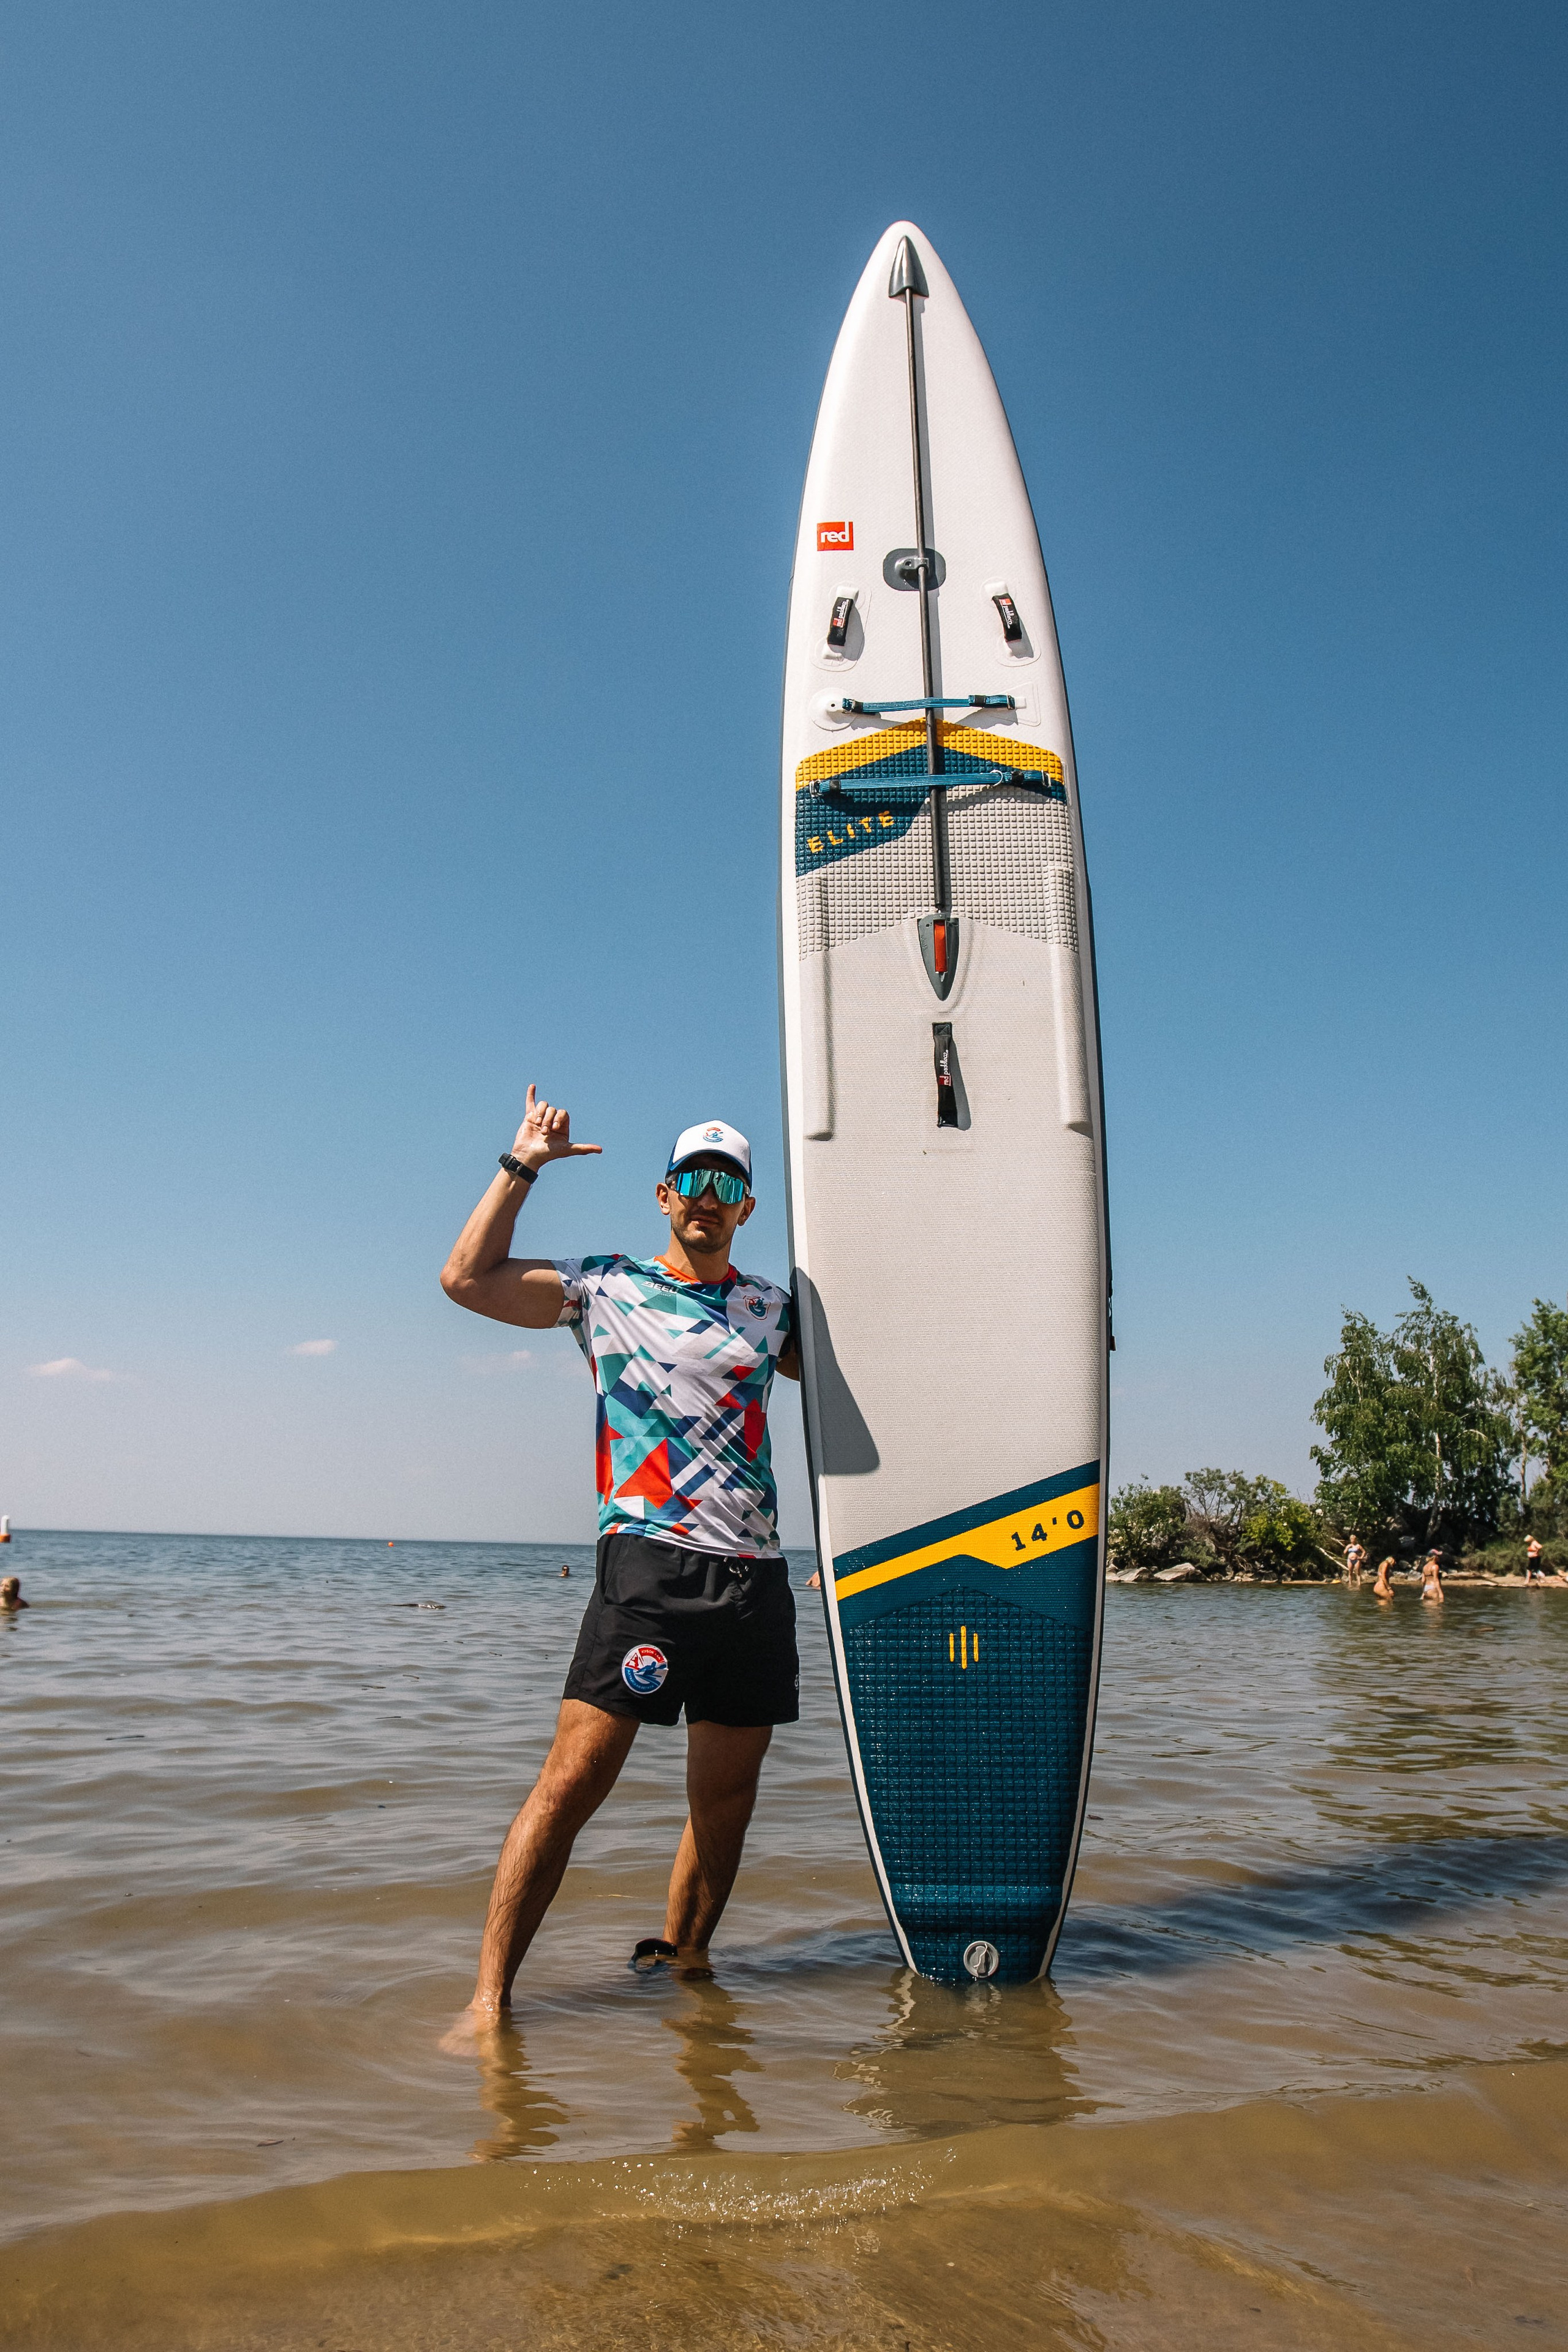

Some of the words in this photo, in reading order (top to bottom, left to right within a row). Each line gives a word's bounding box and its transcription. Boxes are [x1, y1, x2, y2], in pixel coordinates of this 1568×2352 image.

[821, 521, 850, 543] red
[807, 810, 894, 853] ELITE
[940, 1076, 949, 1085] red
[1011, 1510, 1084, 1551] 14'0
